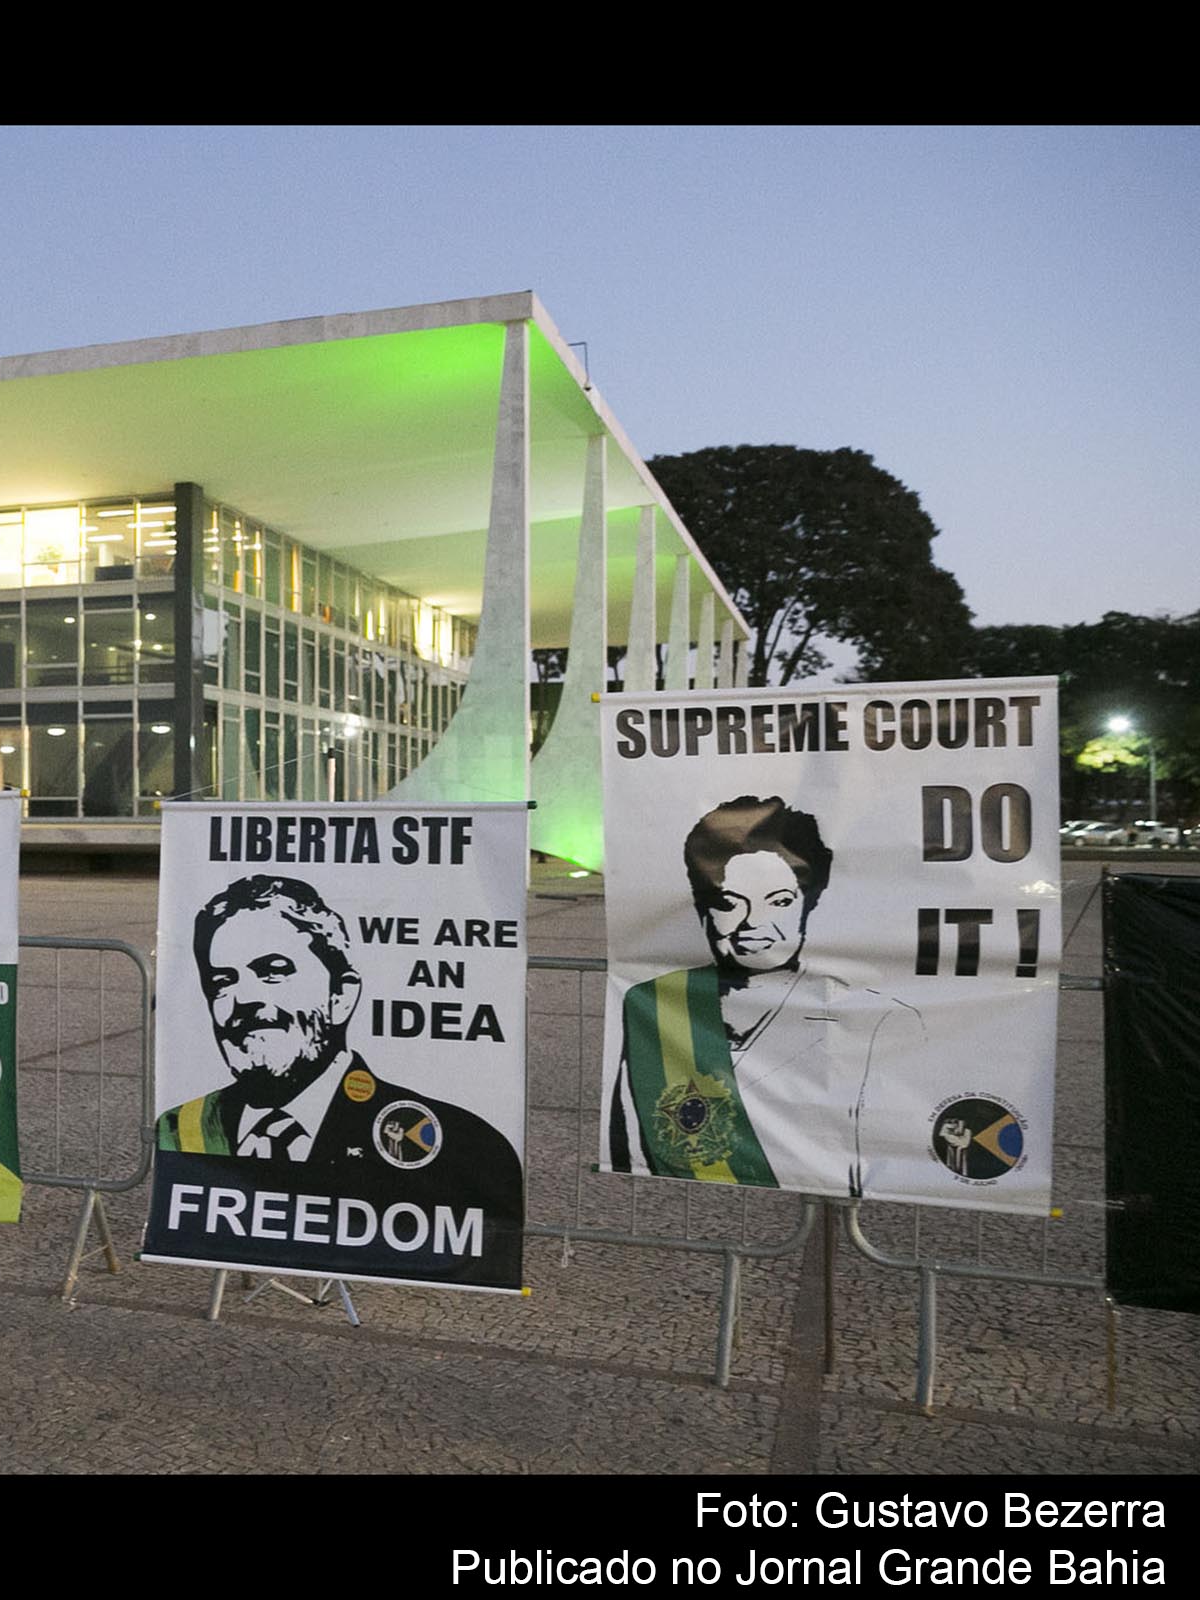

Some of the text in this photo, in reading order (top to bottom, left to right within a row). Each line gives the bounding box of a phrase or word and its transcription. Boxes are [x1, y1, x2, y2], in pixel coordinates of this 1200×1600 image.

[616, 695, 1041, 759] SUPREME COURT
[209, 815, 473, 865] LIBERTA STF
[921, 782, 1033, 863] DO
[358, 916, 518, 948] WE ARE
[407, 959, 465, 989] AN
[371, 999, 505, 1043] IDEA
[167, 1182, 485, 1257] FREEDOM
